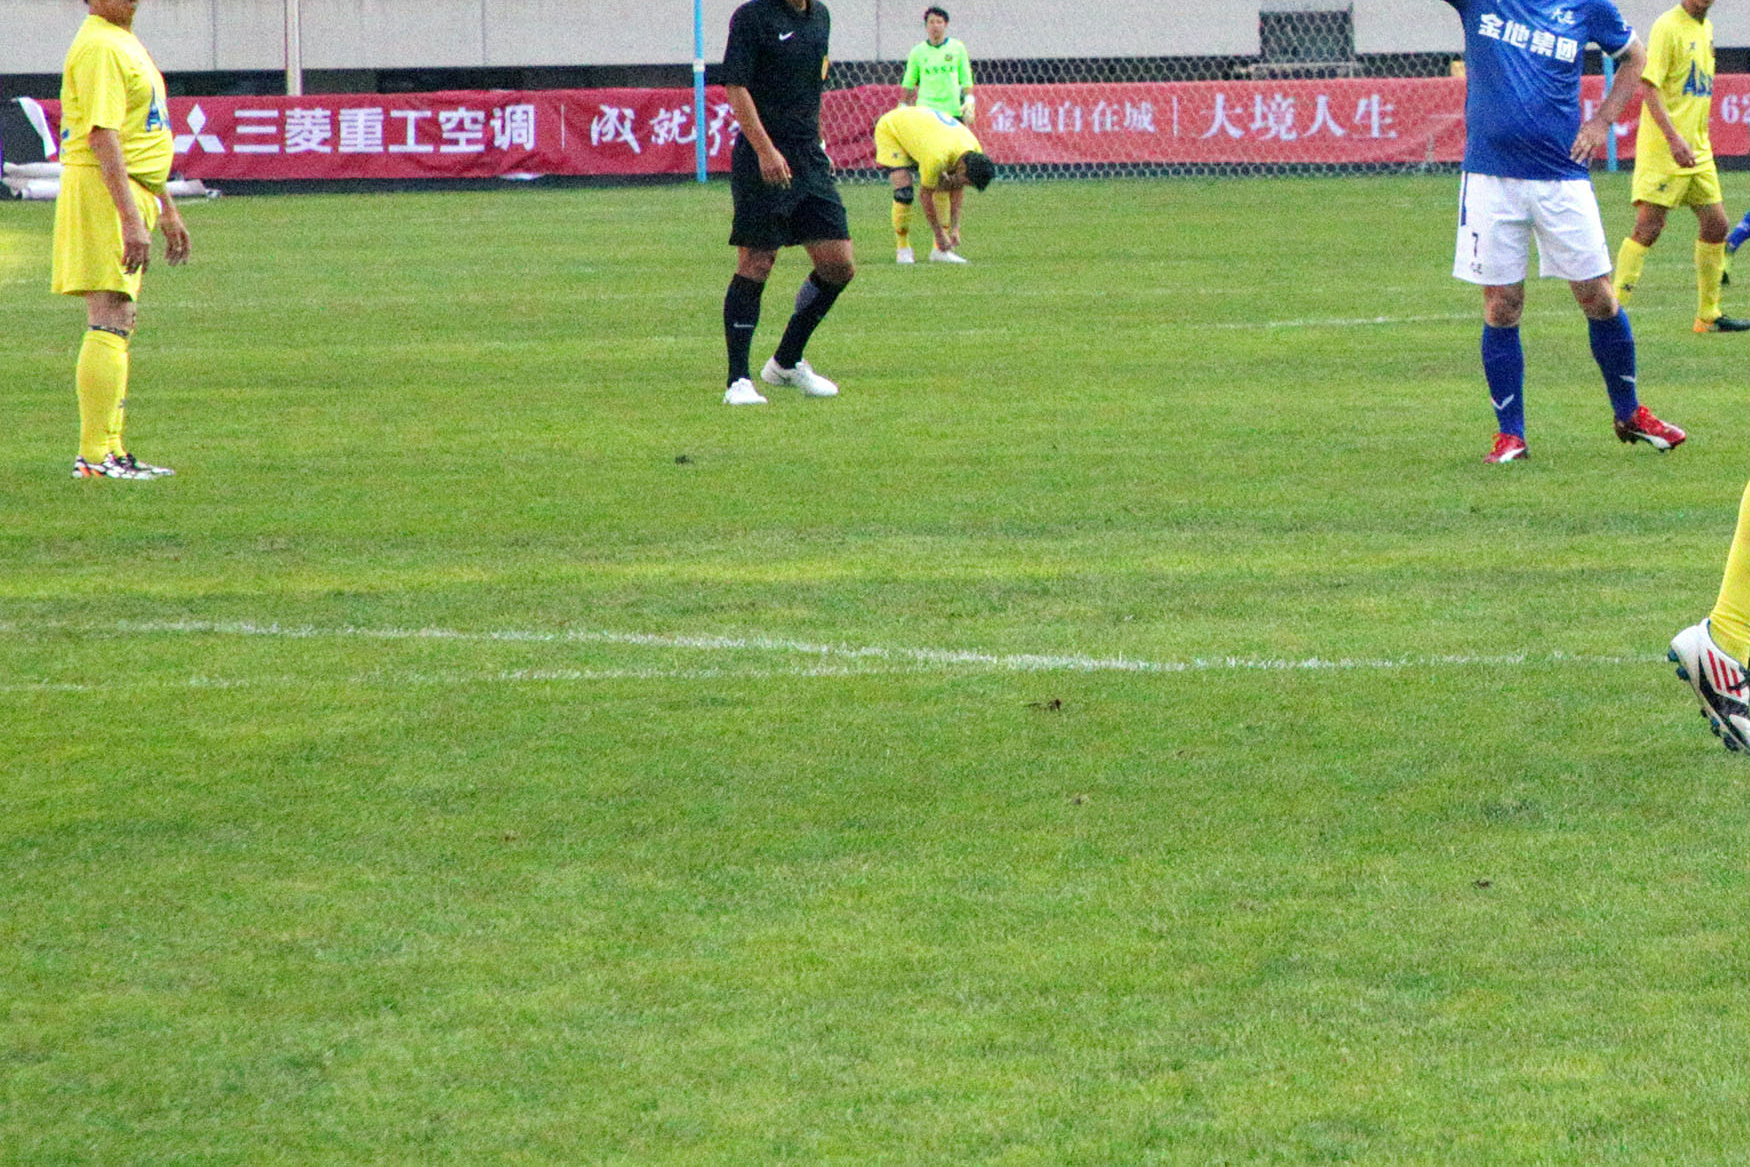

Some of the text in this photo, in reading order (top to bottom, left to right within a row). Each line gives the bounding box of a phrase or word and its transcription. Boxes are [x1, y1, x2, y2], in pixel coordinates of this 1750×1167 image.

[1477, 12, 1579, 64] 金地集团
[232, 103, 537, 154] 三菱重工空调
[988, 100, 1157, 134] 金地自在城
[1200, 92, 1398, 140] 大境人生
